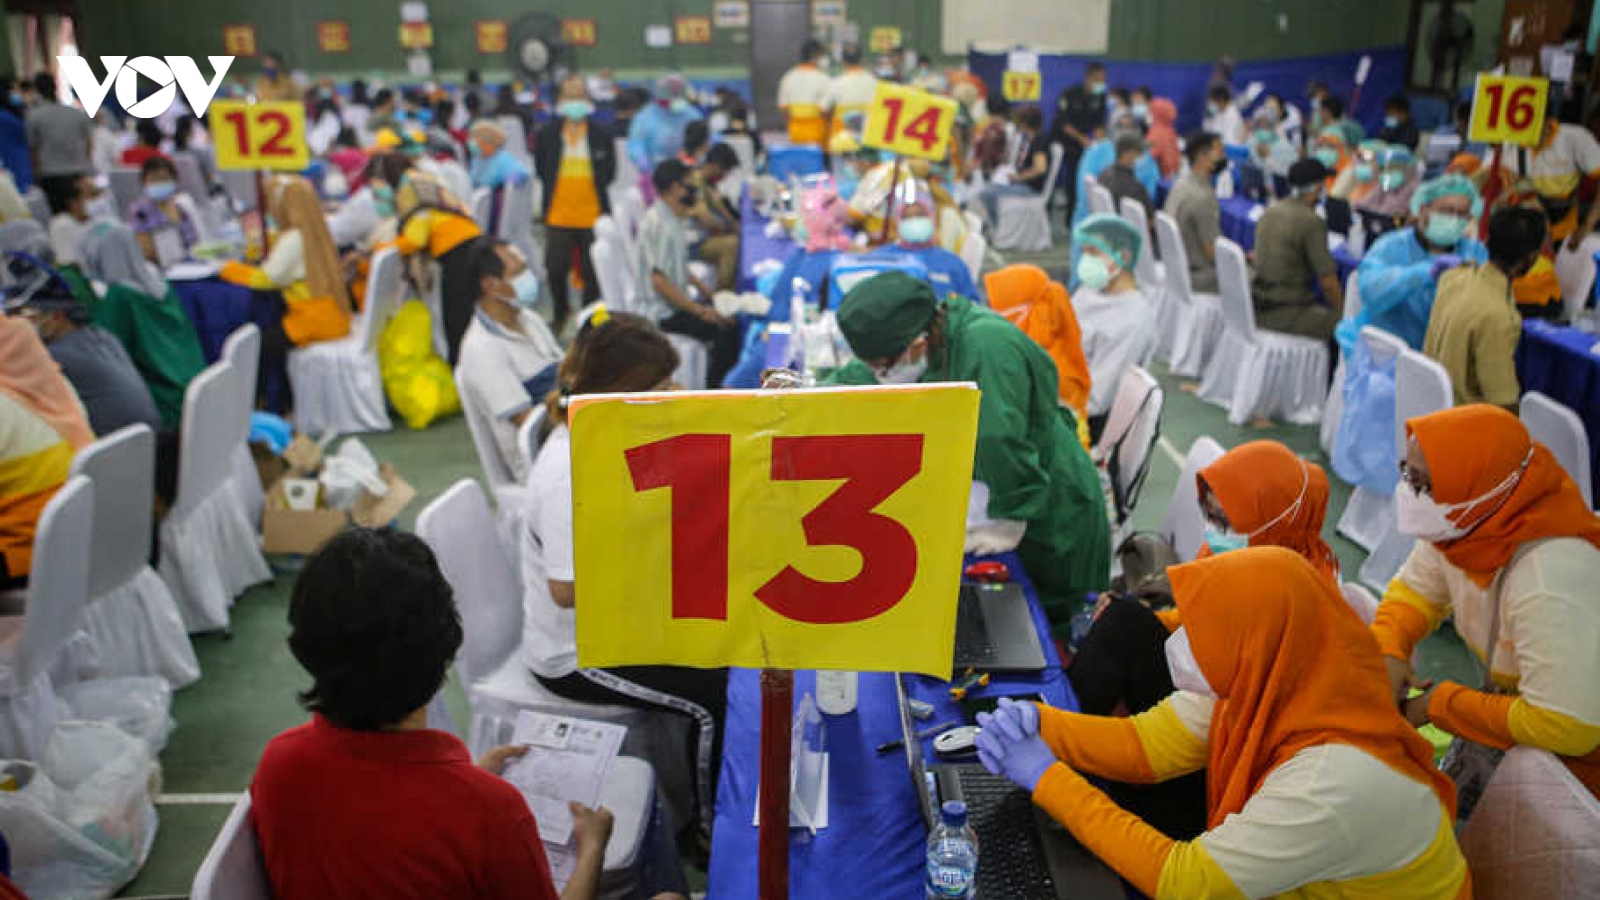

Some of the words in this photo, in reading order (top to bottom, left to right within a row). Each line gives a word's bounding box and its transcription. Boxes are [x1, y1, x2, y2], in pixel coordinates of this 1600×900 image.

[1009, 79, 1035, 96] 17
[1485, 84, 1537, 131] 16
[224, 111, 295, 156] 12
[881, 97, 942, 150] 14
[624, 433, 925, 624] 13
